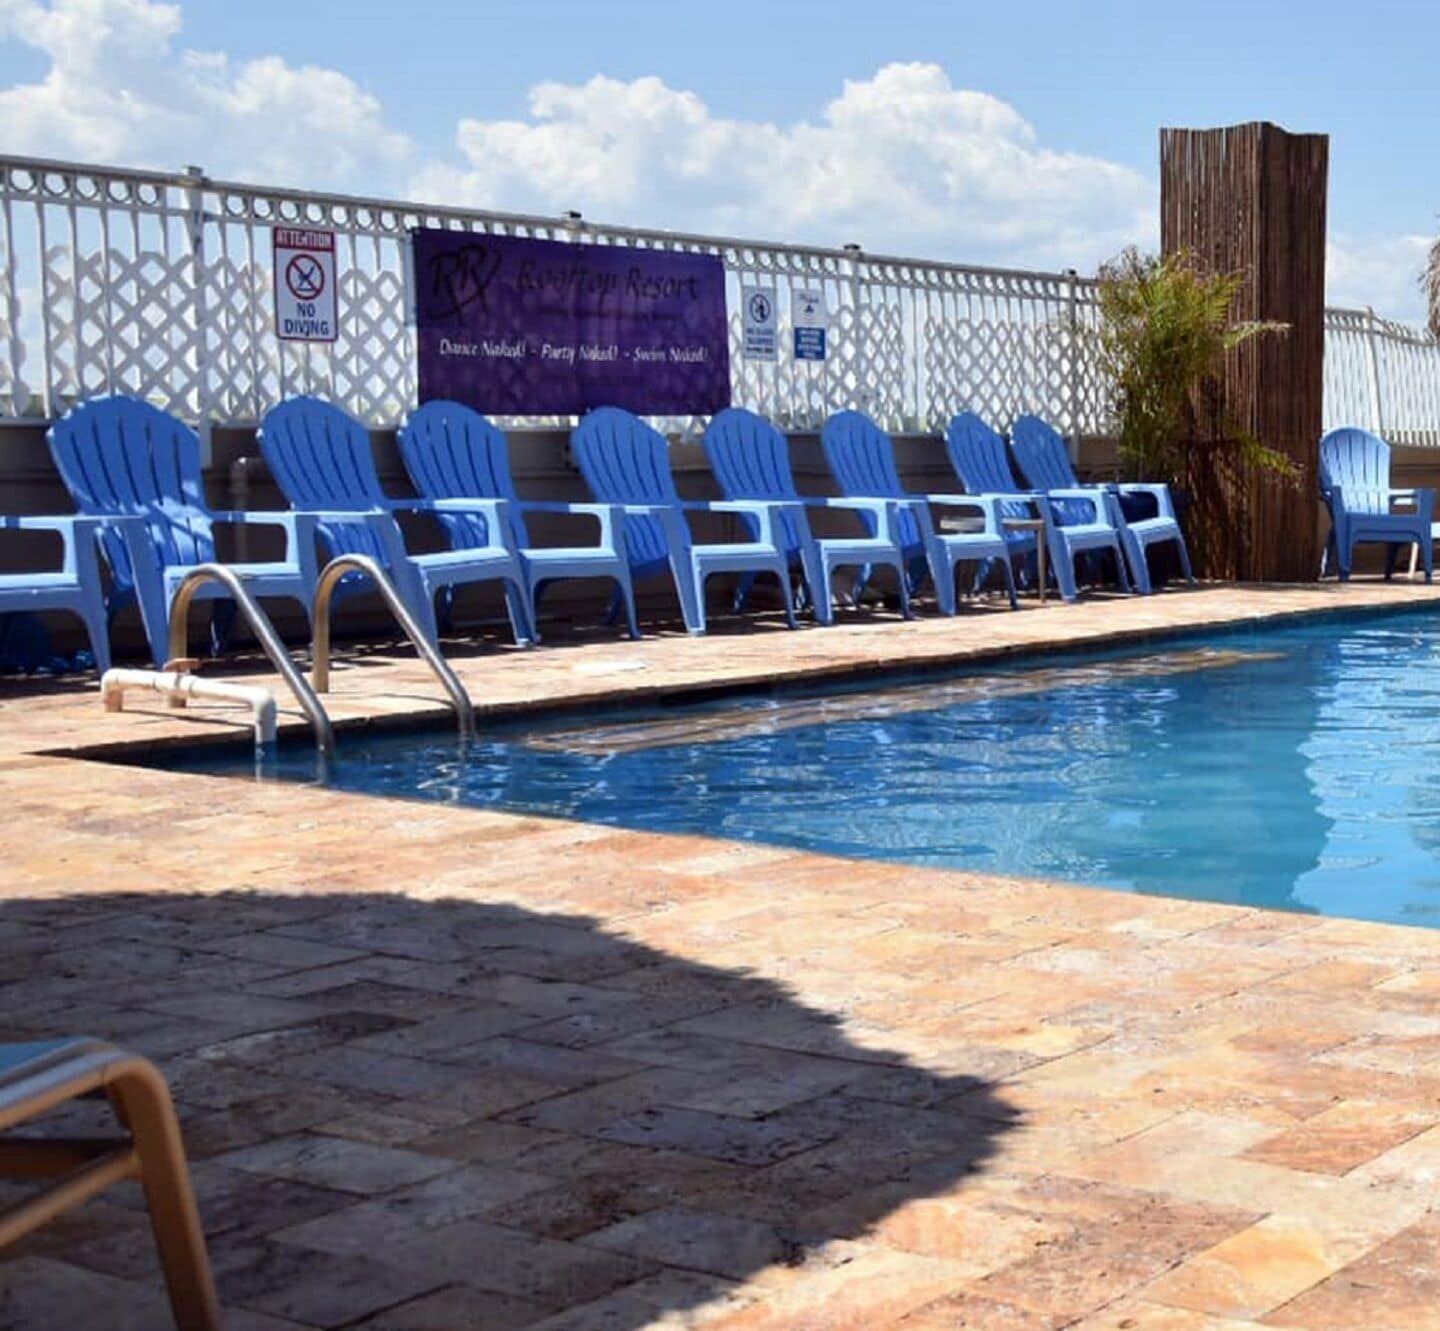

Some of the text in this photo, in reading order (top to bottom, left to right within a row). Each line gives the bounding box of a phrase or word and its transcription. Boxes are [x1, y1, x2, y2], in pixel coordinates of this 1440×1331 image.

[277, 230, 331, 247] ATTENTION
[515, 260, 699, 306] Rooftop Resort
[296, 302, 316, 318] NO
[284, 318, 330, 336] DIVING
[440, 338, 478, 356] Dance
[482, 339, 526, 358] Naked!
[541, 343, 575, 365] Party
[580, 344, 619, 361] Naked!
[633, 345, 666, 362] Swim
[669, 345, 709, 363] Naked!
